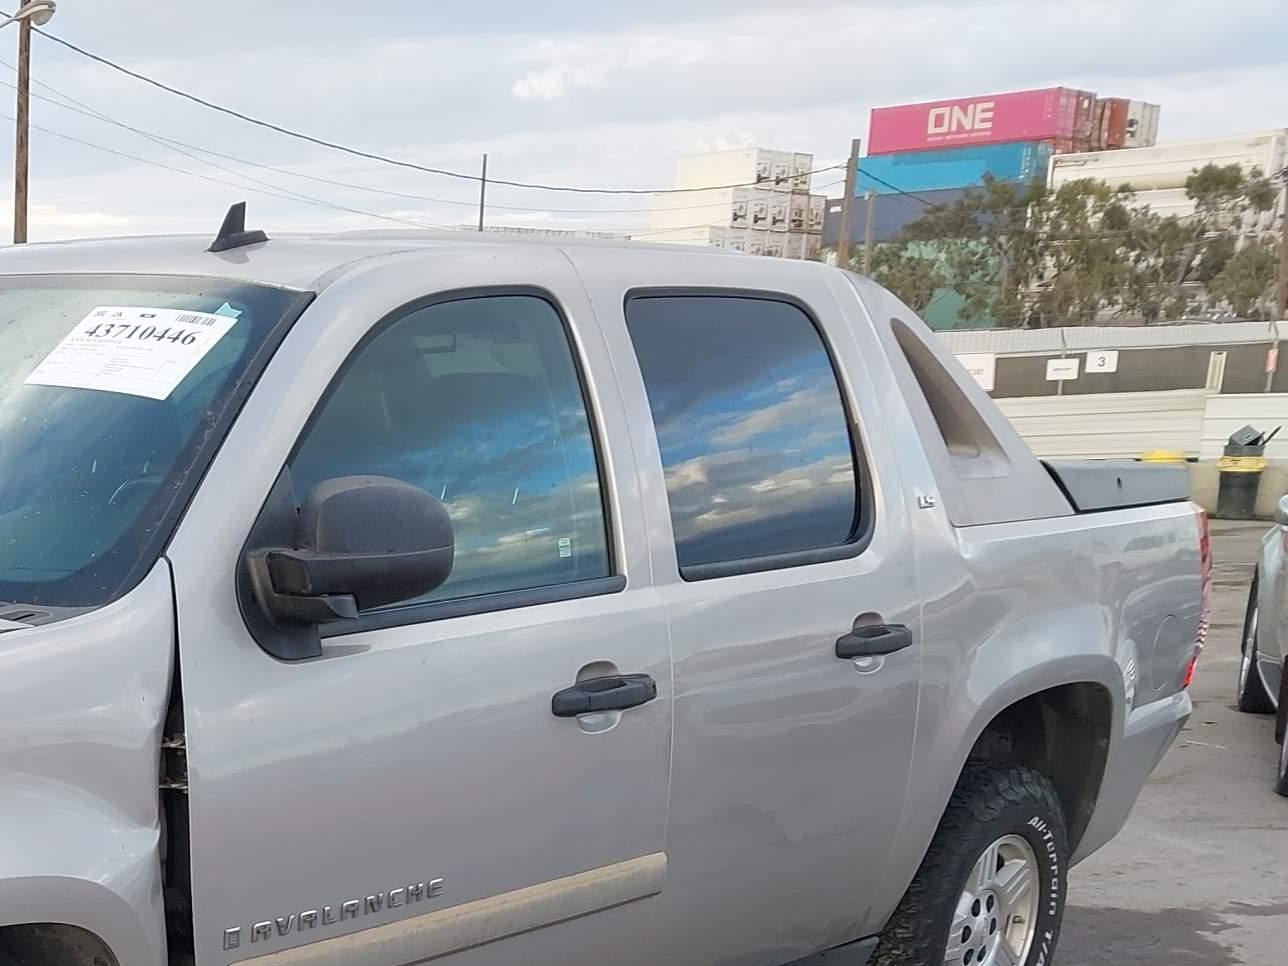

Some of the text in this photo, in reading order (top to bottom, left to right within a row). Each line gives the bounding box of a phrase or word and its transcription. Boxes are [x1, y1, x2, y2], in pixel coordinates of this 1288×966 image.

[927, 102, 995, 134] ONE
[85, 322, 201, 346] 43710446
[1097, 356, 1107, 367] 3
[250, 877, 444, 943] AVALANCHE
